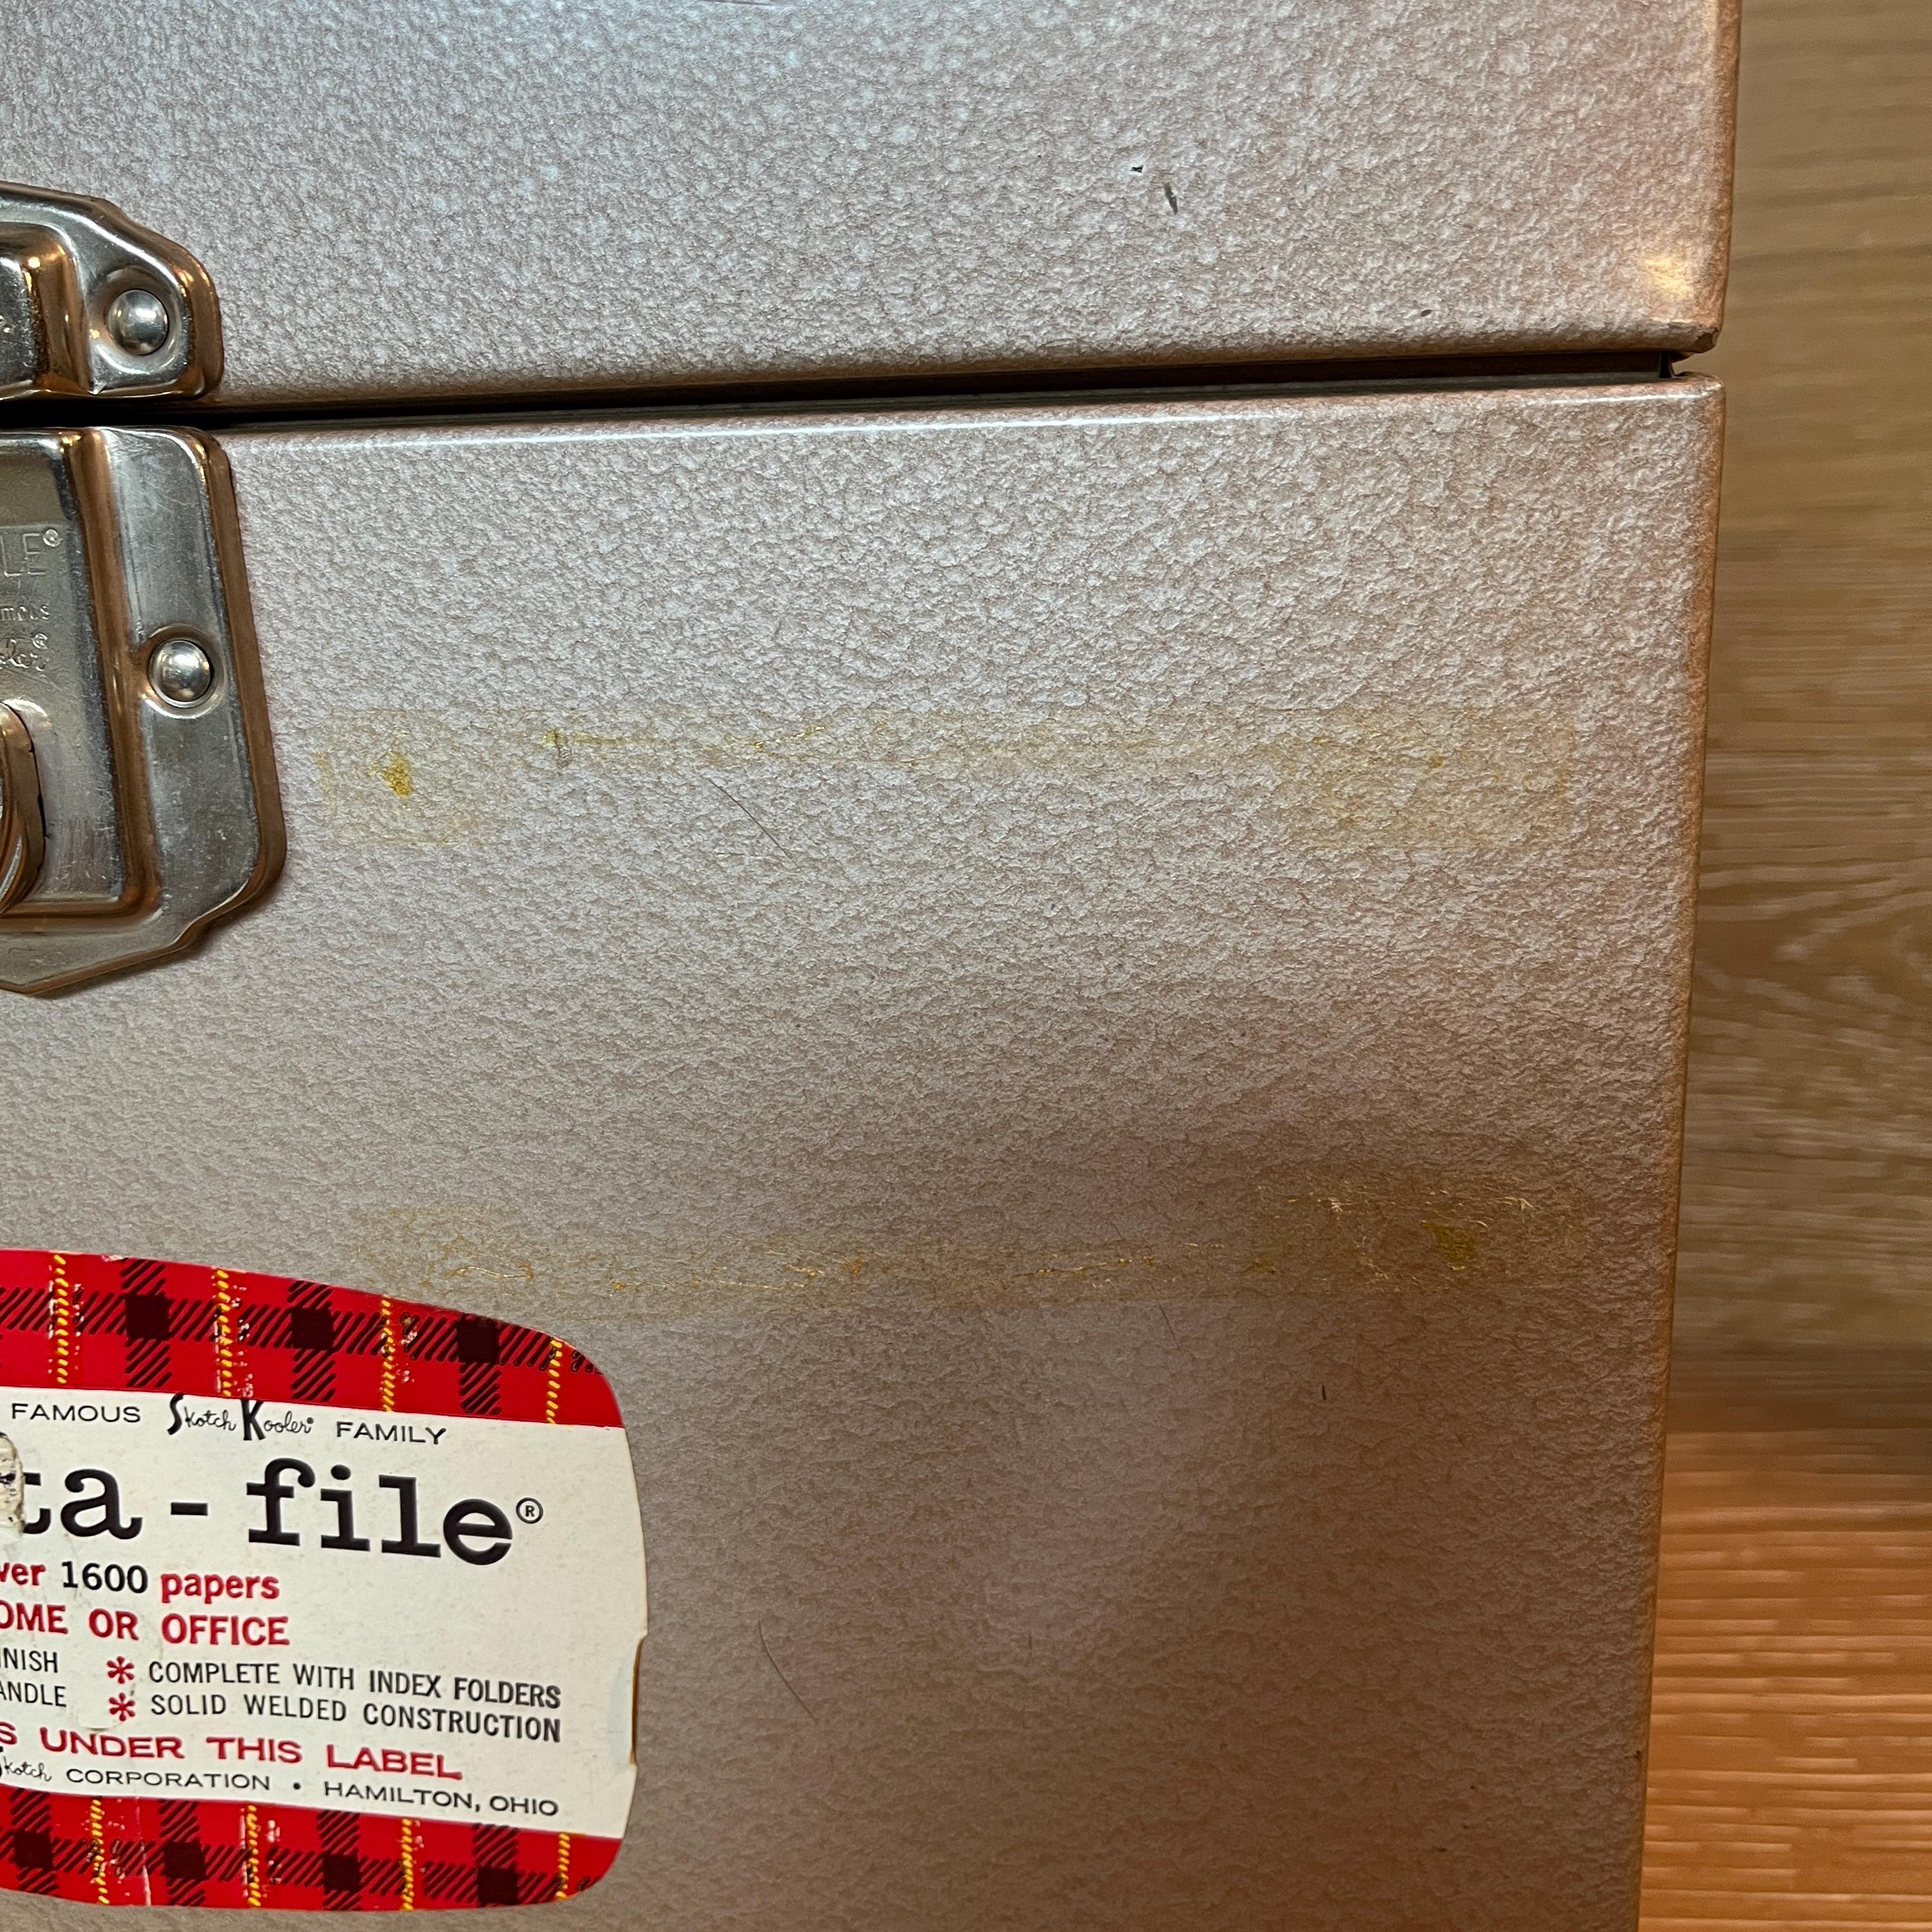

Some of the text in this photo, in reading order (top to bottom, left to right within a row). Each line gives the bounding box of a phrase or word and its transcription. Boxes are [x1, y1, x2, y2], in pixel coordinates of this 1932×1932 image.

[12, 1403, 140, 1423] FAMOUS
[167, 1393, 236, 1435] Skotch
[337, 1421, 446, 1444] FAMILY
[62, 1561, 147, 1593] 1600
[161, 1574, 279, 1604] papers
[89, 1609, 138, 1640] OR
[162, 1614, 289, 1645] OFFICE
[149, 1662, 560, 1709] COMPLETE WITH INDEX FOLDERS
[151, 1694, 560, 1742] SOLID WELDED CONSTRUCTION
[40, 1727, 184, 1759] UNDER
[206, 1738, 301, 1763] THIS
[327, 1745, 462, 1780] LABEL
[66, 1769, 269, 1790] CORPORATION
[324, 1781, 480, 1812] HAMILTON,
[490, 1796, 558, 1816] OHIO
